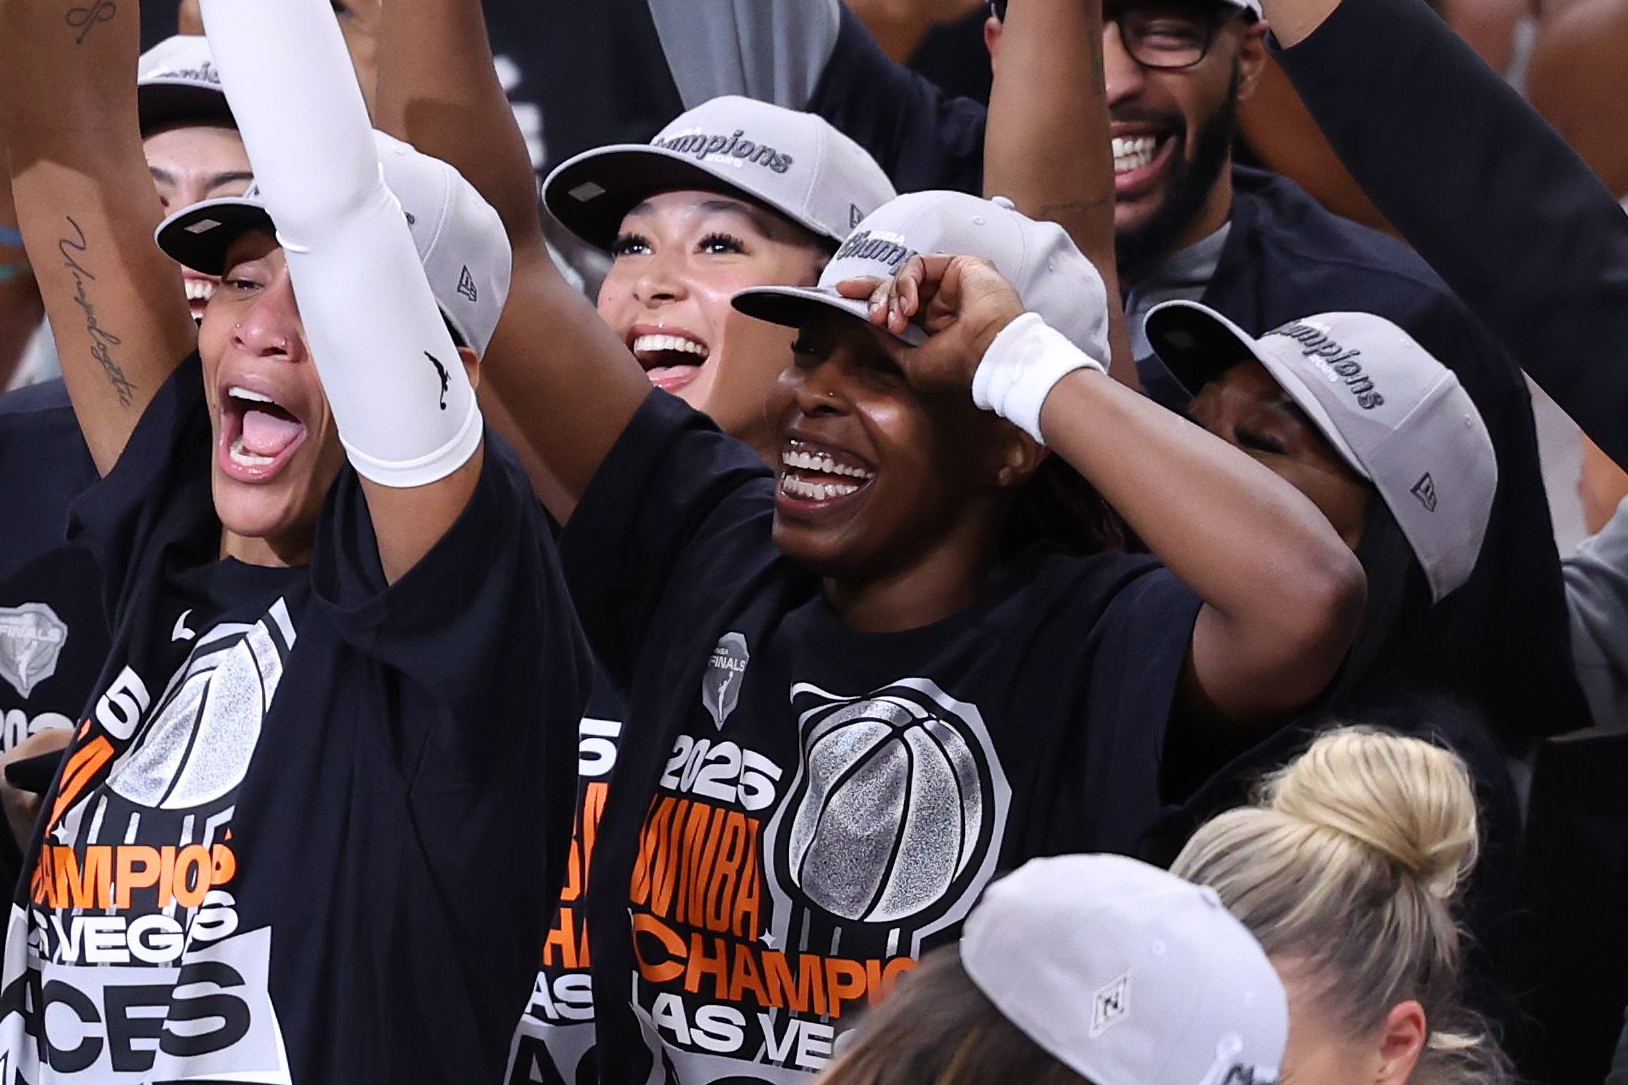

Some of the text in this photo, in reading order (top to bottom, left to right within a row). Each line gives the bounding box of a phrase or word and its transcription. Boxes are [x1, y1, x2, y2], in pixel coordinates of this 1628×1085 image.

[659, 734, 783, 811] 2025
[630, 792, 761, 943] WNBA
[0, 960, 253, 1074] ACES
